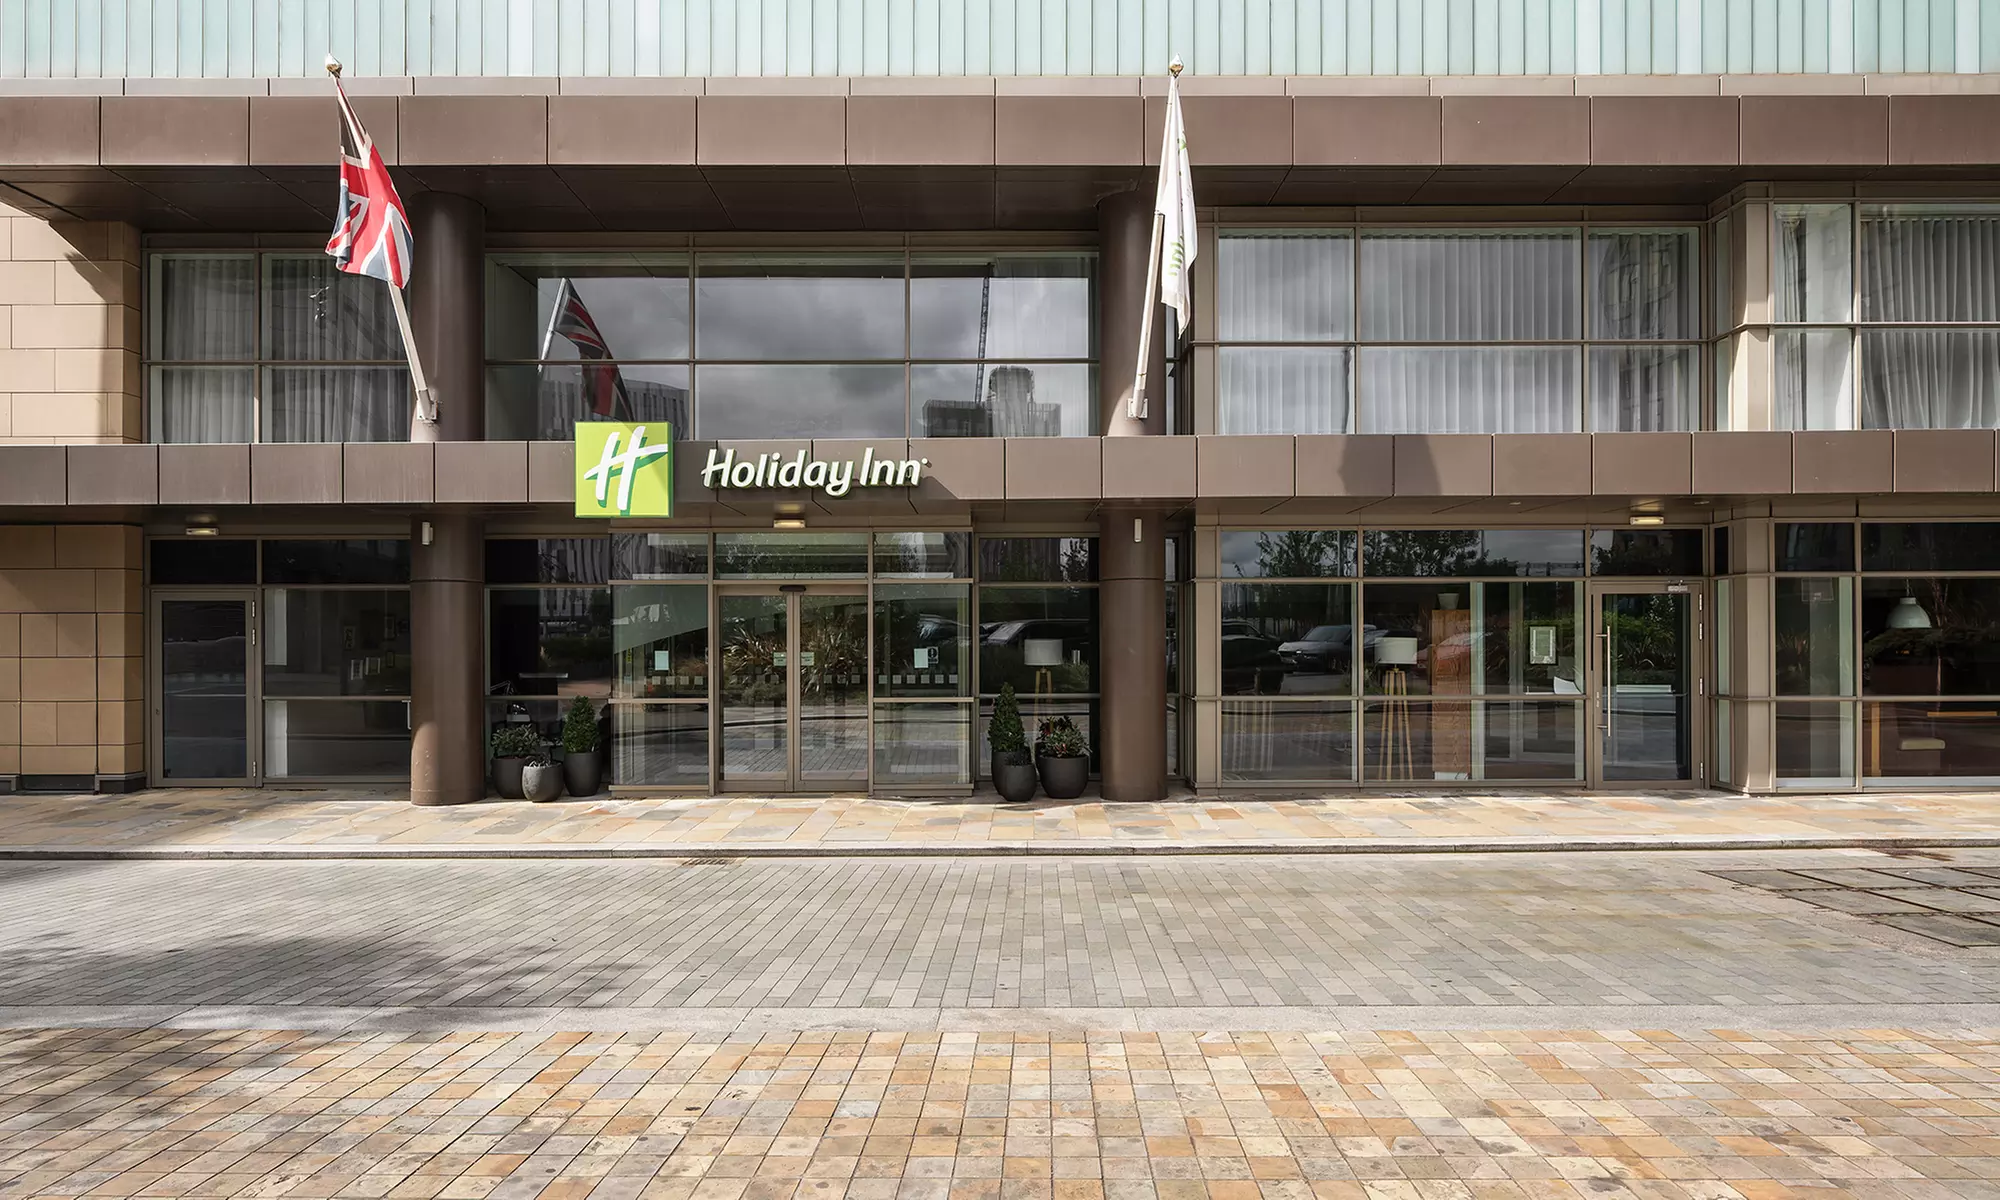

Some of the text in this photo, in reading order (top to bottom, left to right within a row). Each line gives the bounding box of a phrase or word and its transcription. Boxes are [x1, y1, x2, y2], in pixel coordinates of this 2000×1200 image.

[583, 426, 669, 513] H
[701, 447, 923, 497] Holiday Inn
